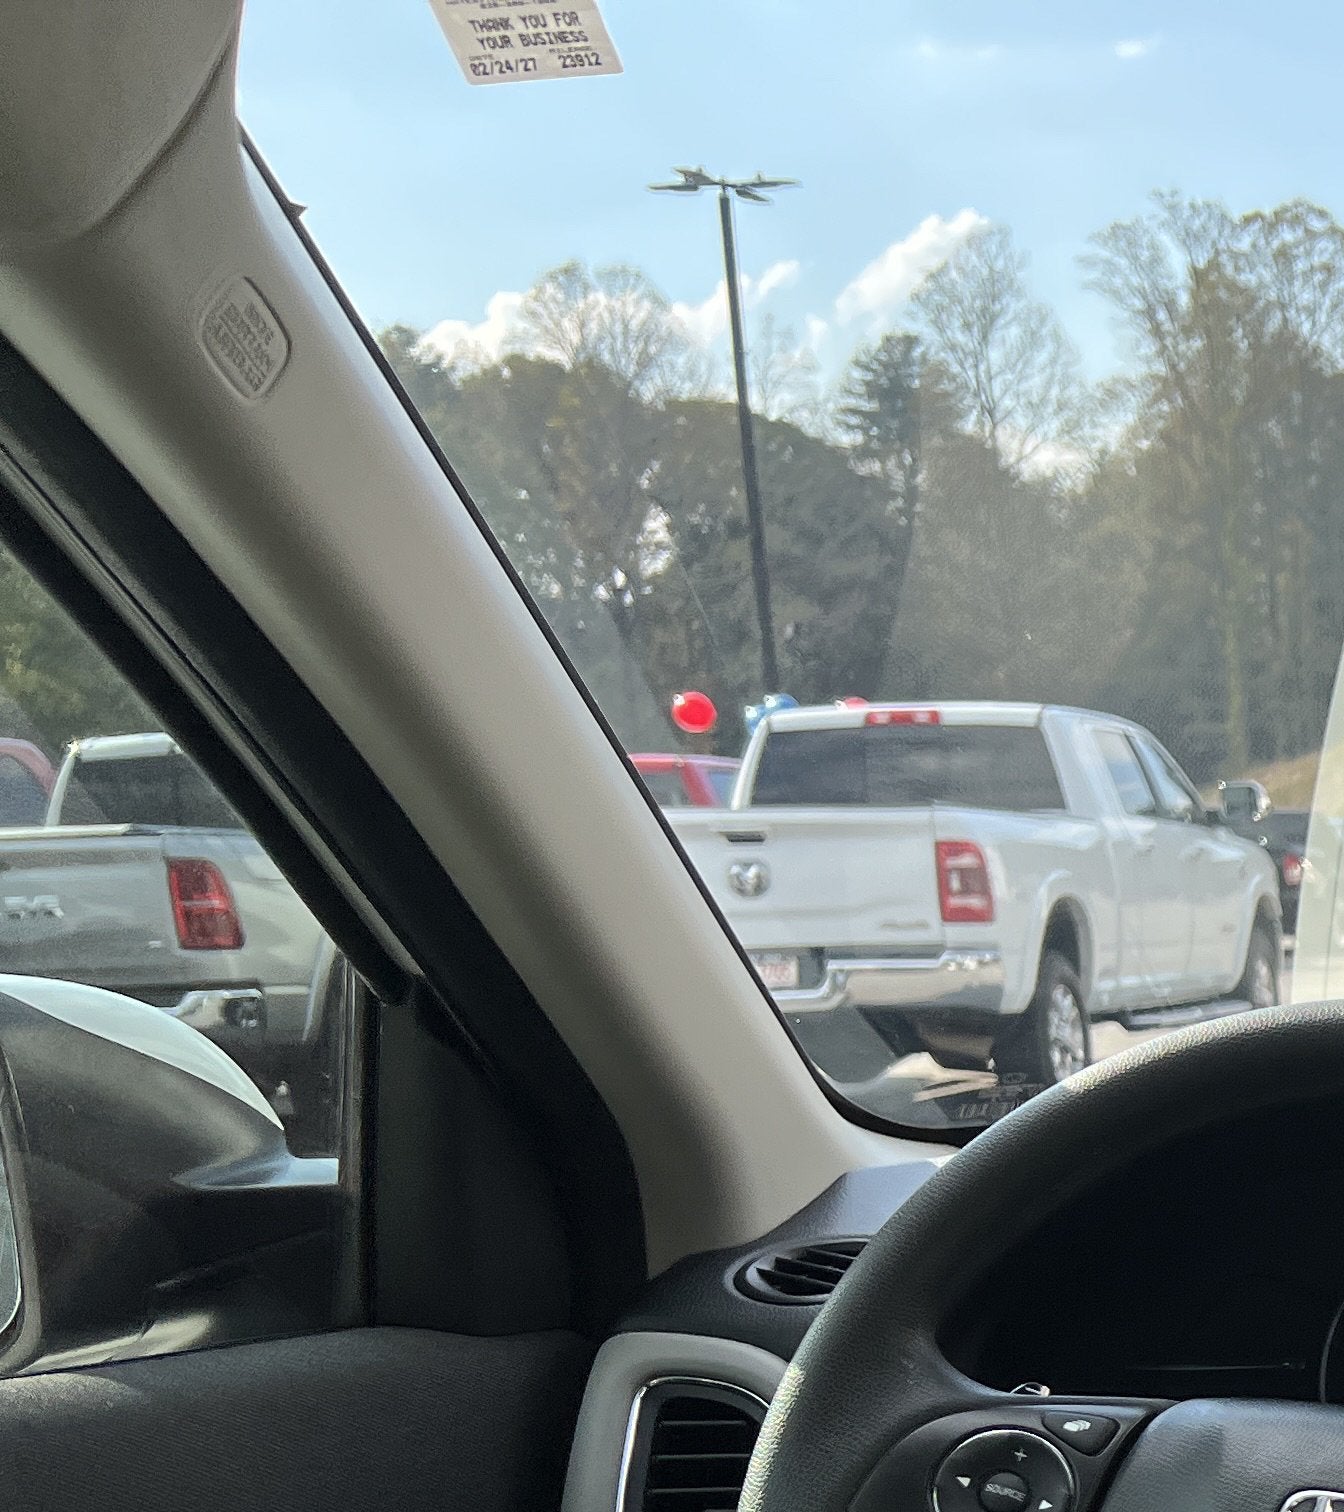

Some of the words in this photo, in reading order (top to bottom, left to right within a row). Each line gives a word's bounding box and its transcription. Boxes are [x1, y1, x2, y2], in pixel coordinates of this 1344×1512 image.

[468, 16, 515, 33] THANK
[519, 14, 548, 29] YOU
[552, 11, 582, 28] FOR
[476, 34, 514, 51] YOUR
[518, 30, 589, 47] BUSINESS
[469, 58, 538, 76] 02/24/27
[558, 53, 602, 69] 23912
[985, 1483, 1026, 1502] SOURCE
